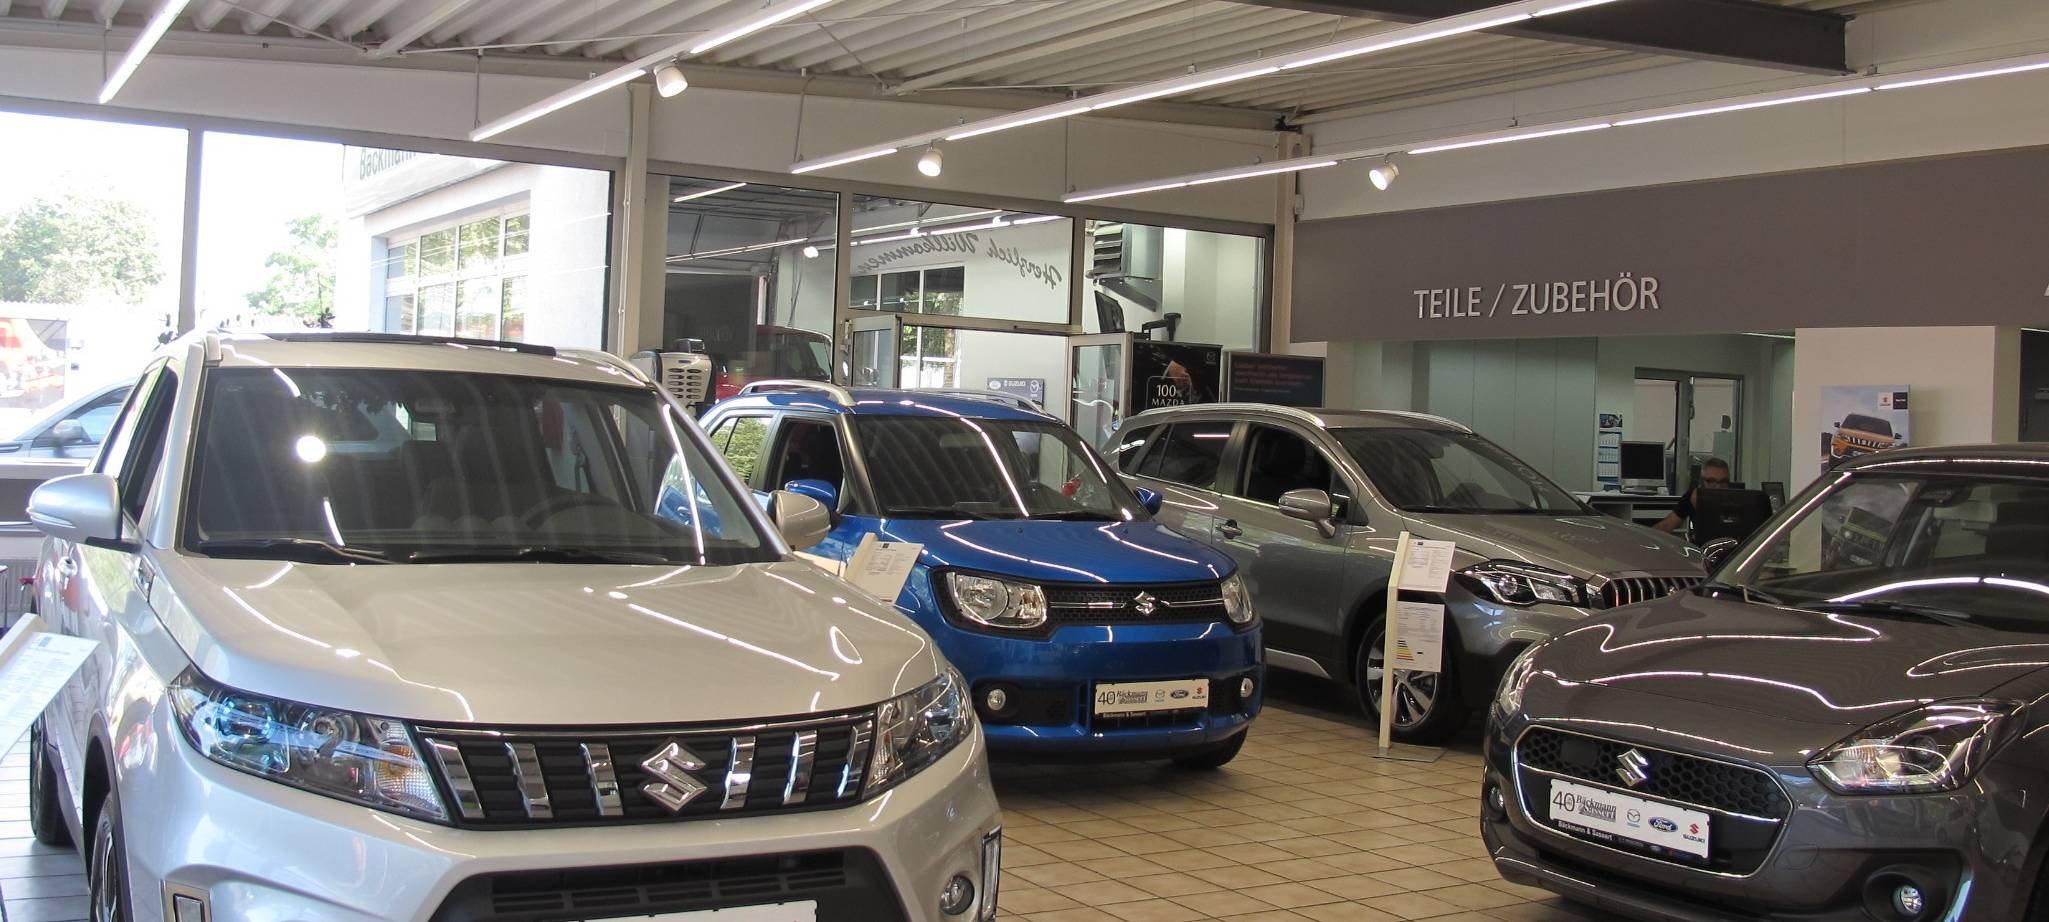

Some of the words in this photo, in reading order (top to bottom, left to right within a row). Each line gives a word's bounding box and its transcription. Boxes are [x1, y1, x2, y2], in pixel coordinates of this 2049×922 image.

[1413, 287, 1482, 319] TEILE
[1488, 283, 1507, 318] /
[1511, 271, 1660, 316] ZUBEHÖR
[1156, 384, 1177, 397] 100
[1151, 398, 1185, 407] MAZDA
[1097, 690, 1116, 706] 40
[1552, 791, 1576, 812] 40
[1576, 794, 1617, 813] Bäckmann
[1653, 818, 1673, 831] Ford
